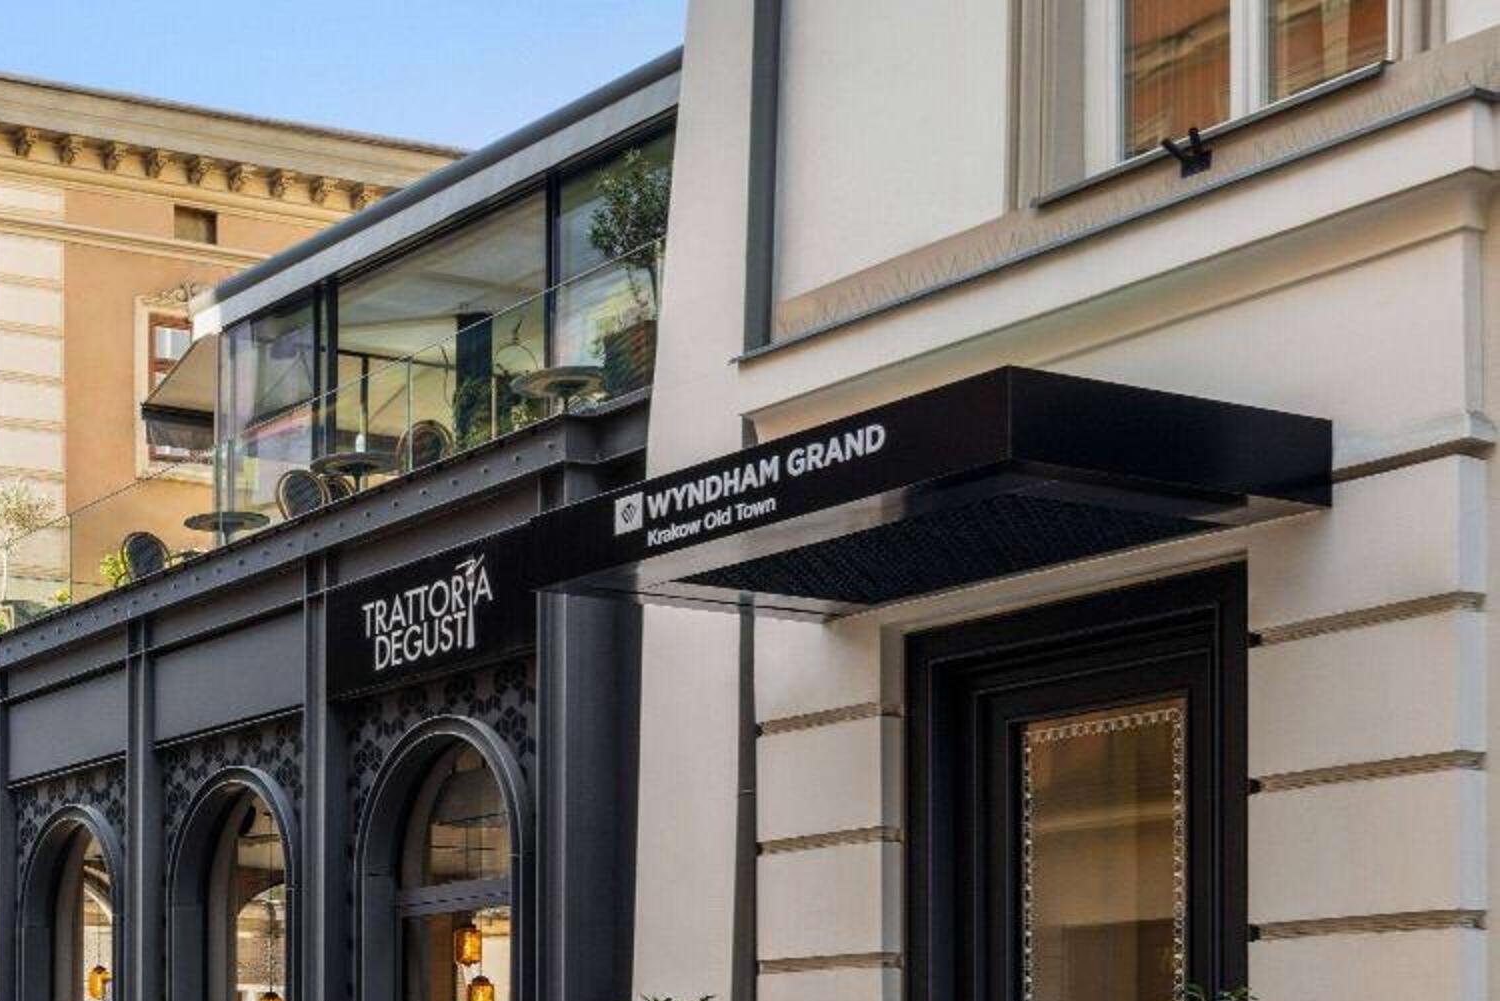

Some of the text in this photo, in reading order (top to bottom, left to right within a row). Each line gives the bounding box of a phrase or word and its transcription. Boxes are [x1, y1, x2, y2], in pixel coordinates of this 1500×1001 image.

[647, 424, 885, 518] WYNDHAM GRAND
[647, 497, 776, 546] Krakow Old Town
[362, 554, 493, 638] TRATTORIA
